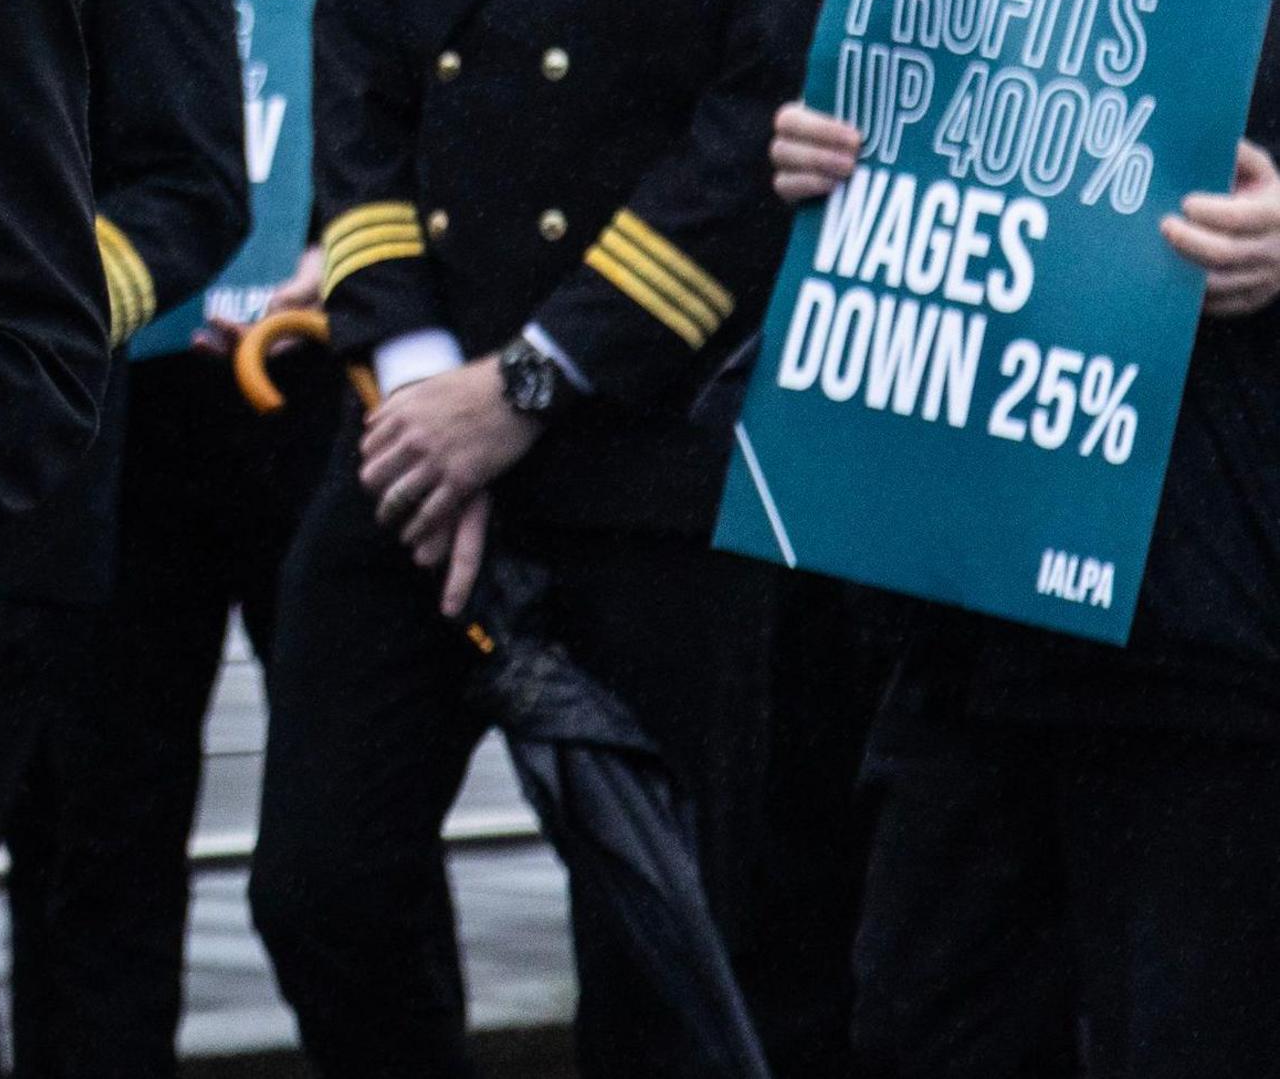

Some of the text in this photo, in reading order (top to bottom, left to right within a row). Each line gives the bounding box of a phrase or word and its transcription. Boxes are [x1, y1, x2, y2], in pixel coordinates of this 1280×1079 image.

[835, 38, 1156, 215] UP 400%
[814, 165, 1048, 313] WAGES
[776, 277, 1142, 465] DOWN 25%
[1036, 547, 1115, 610] IALPA
